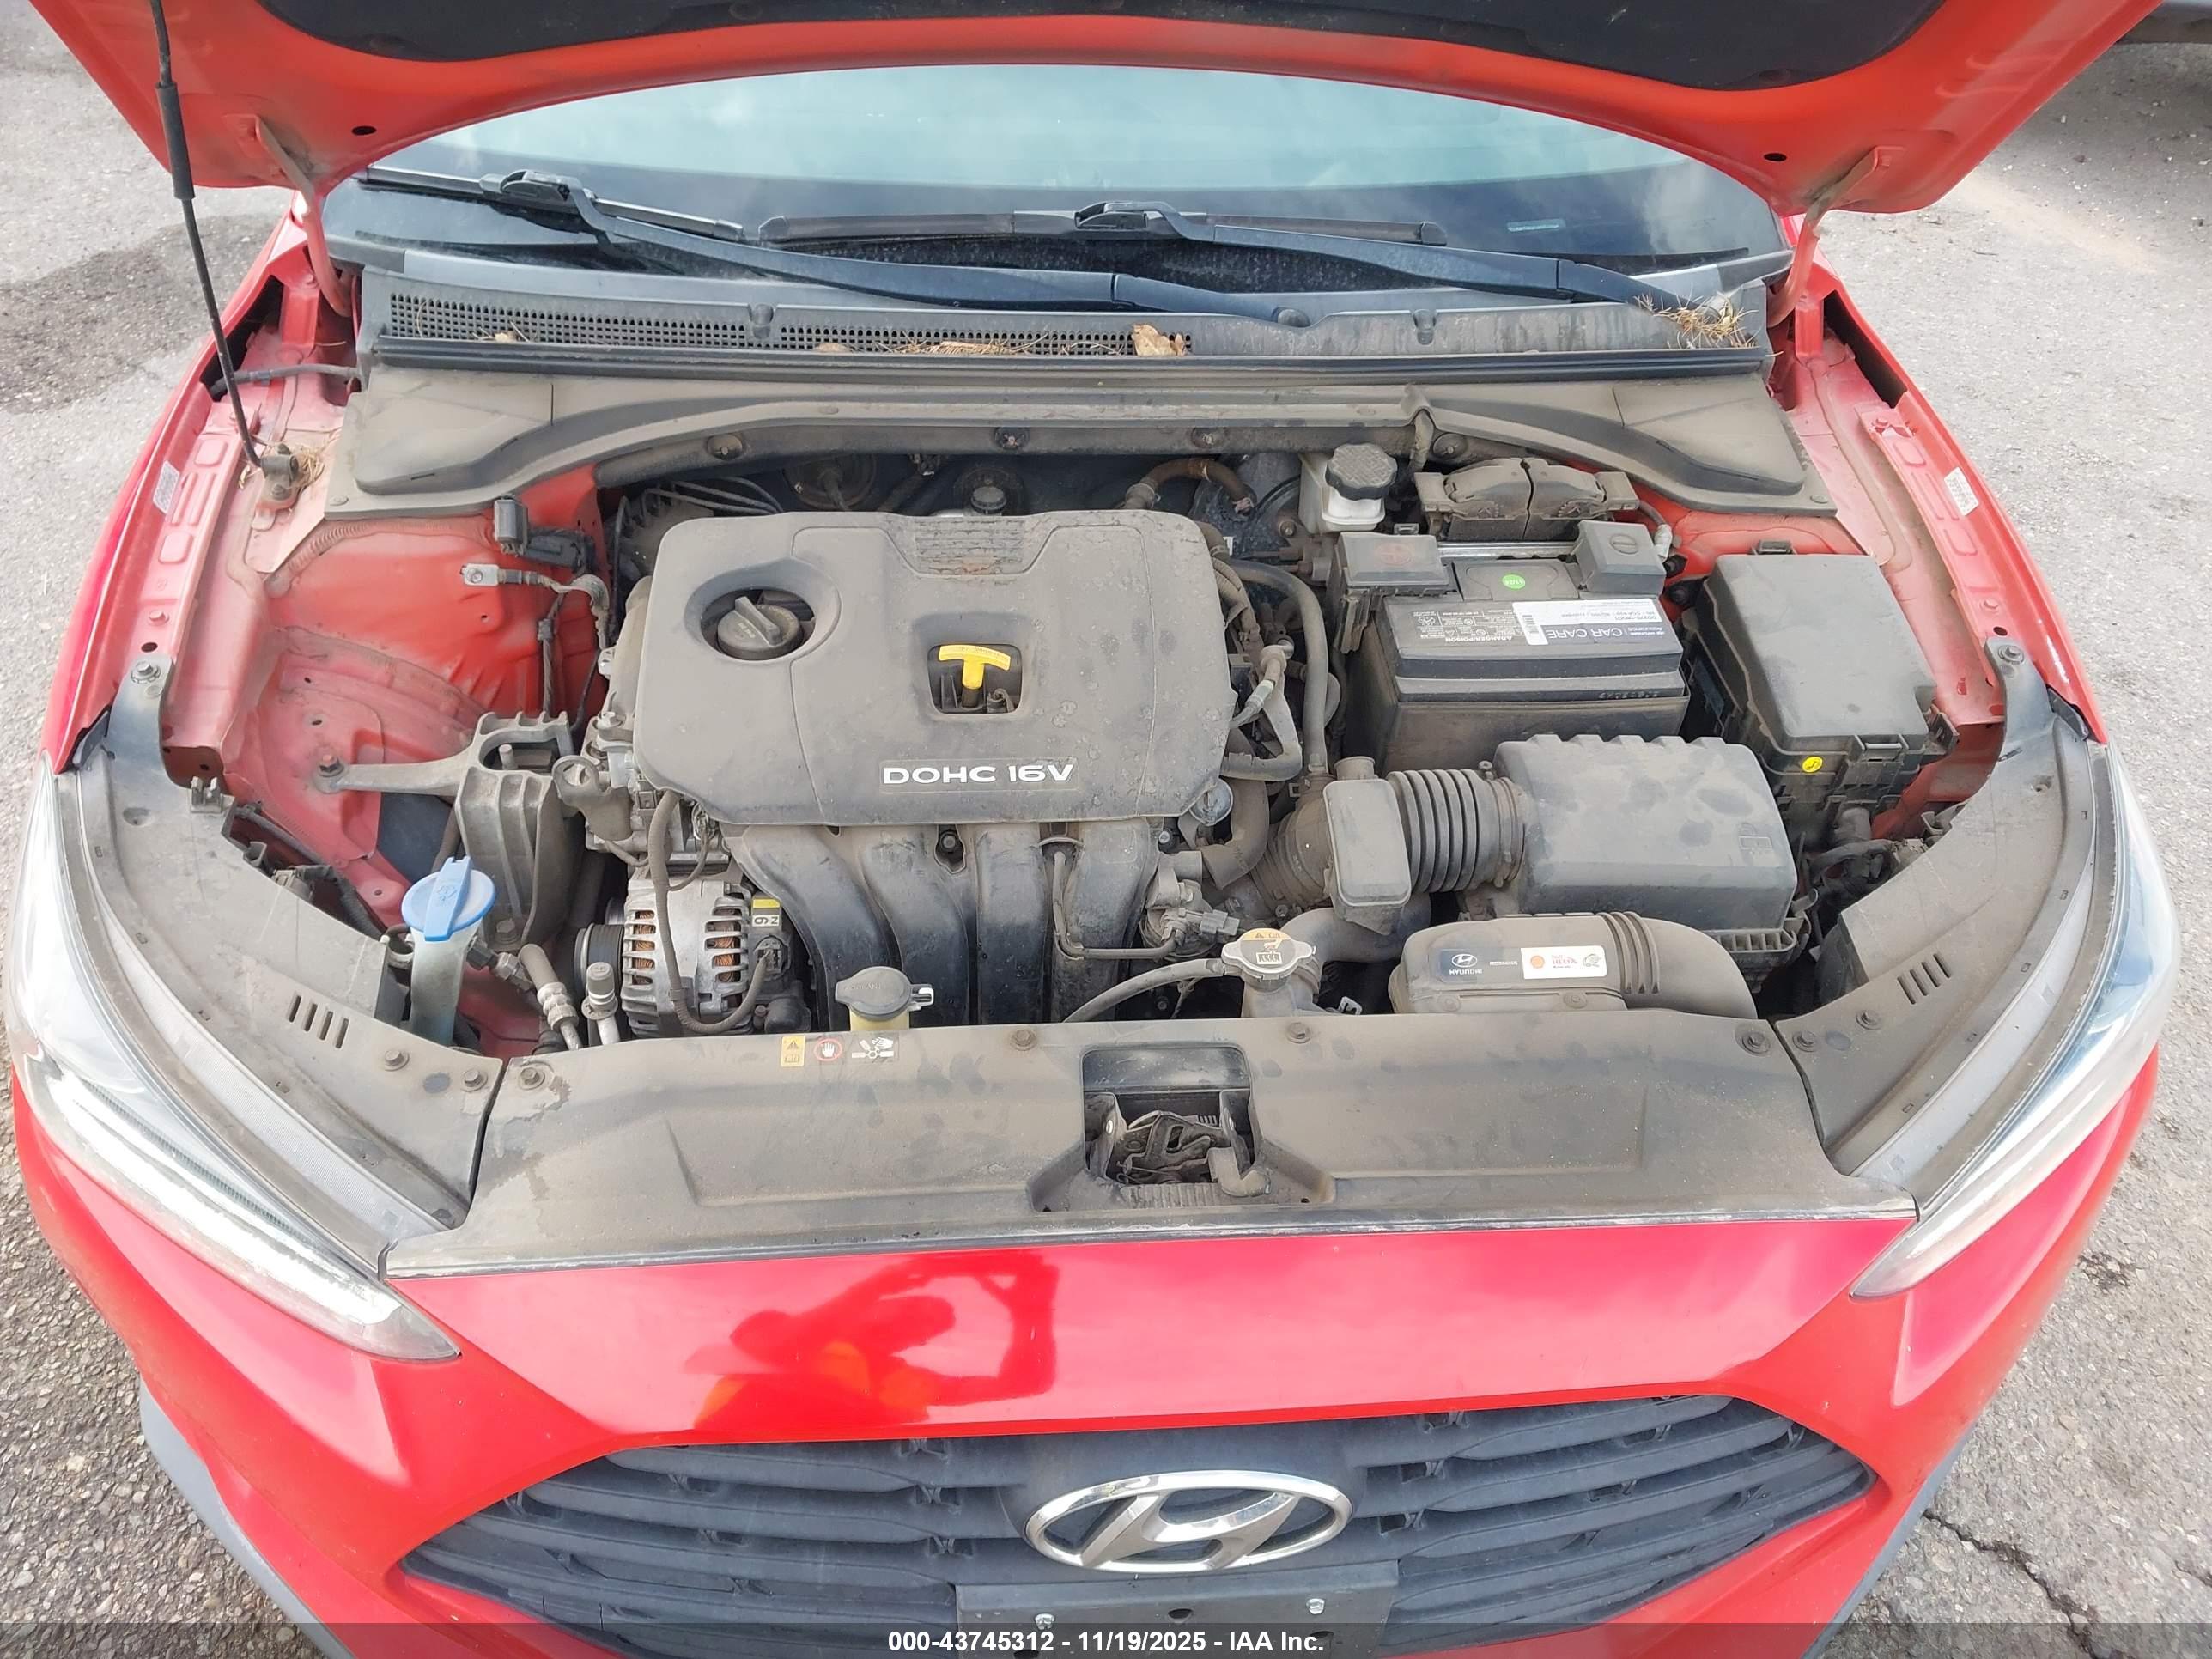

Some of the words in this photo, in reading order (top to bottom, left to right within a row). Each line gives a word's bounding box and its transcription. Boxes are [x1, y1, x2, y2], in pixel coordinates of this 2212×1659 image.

[1545, 628, 1588, 639] CARE
[1590, 627, 1623, 638] CAR
[883, 766, 997, 784] DOHC
[1007, 764, 1074, 782] 16V
[1449, 968, 1483, 976] HYUNDAI
